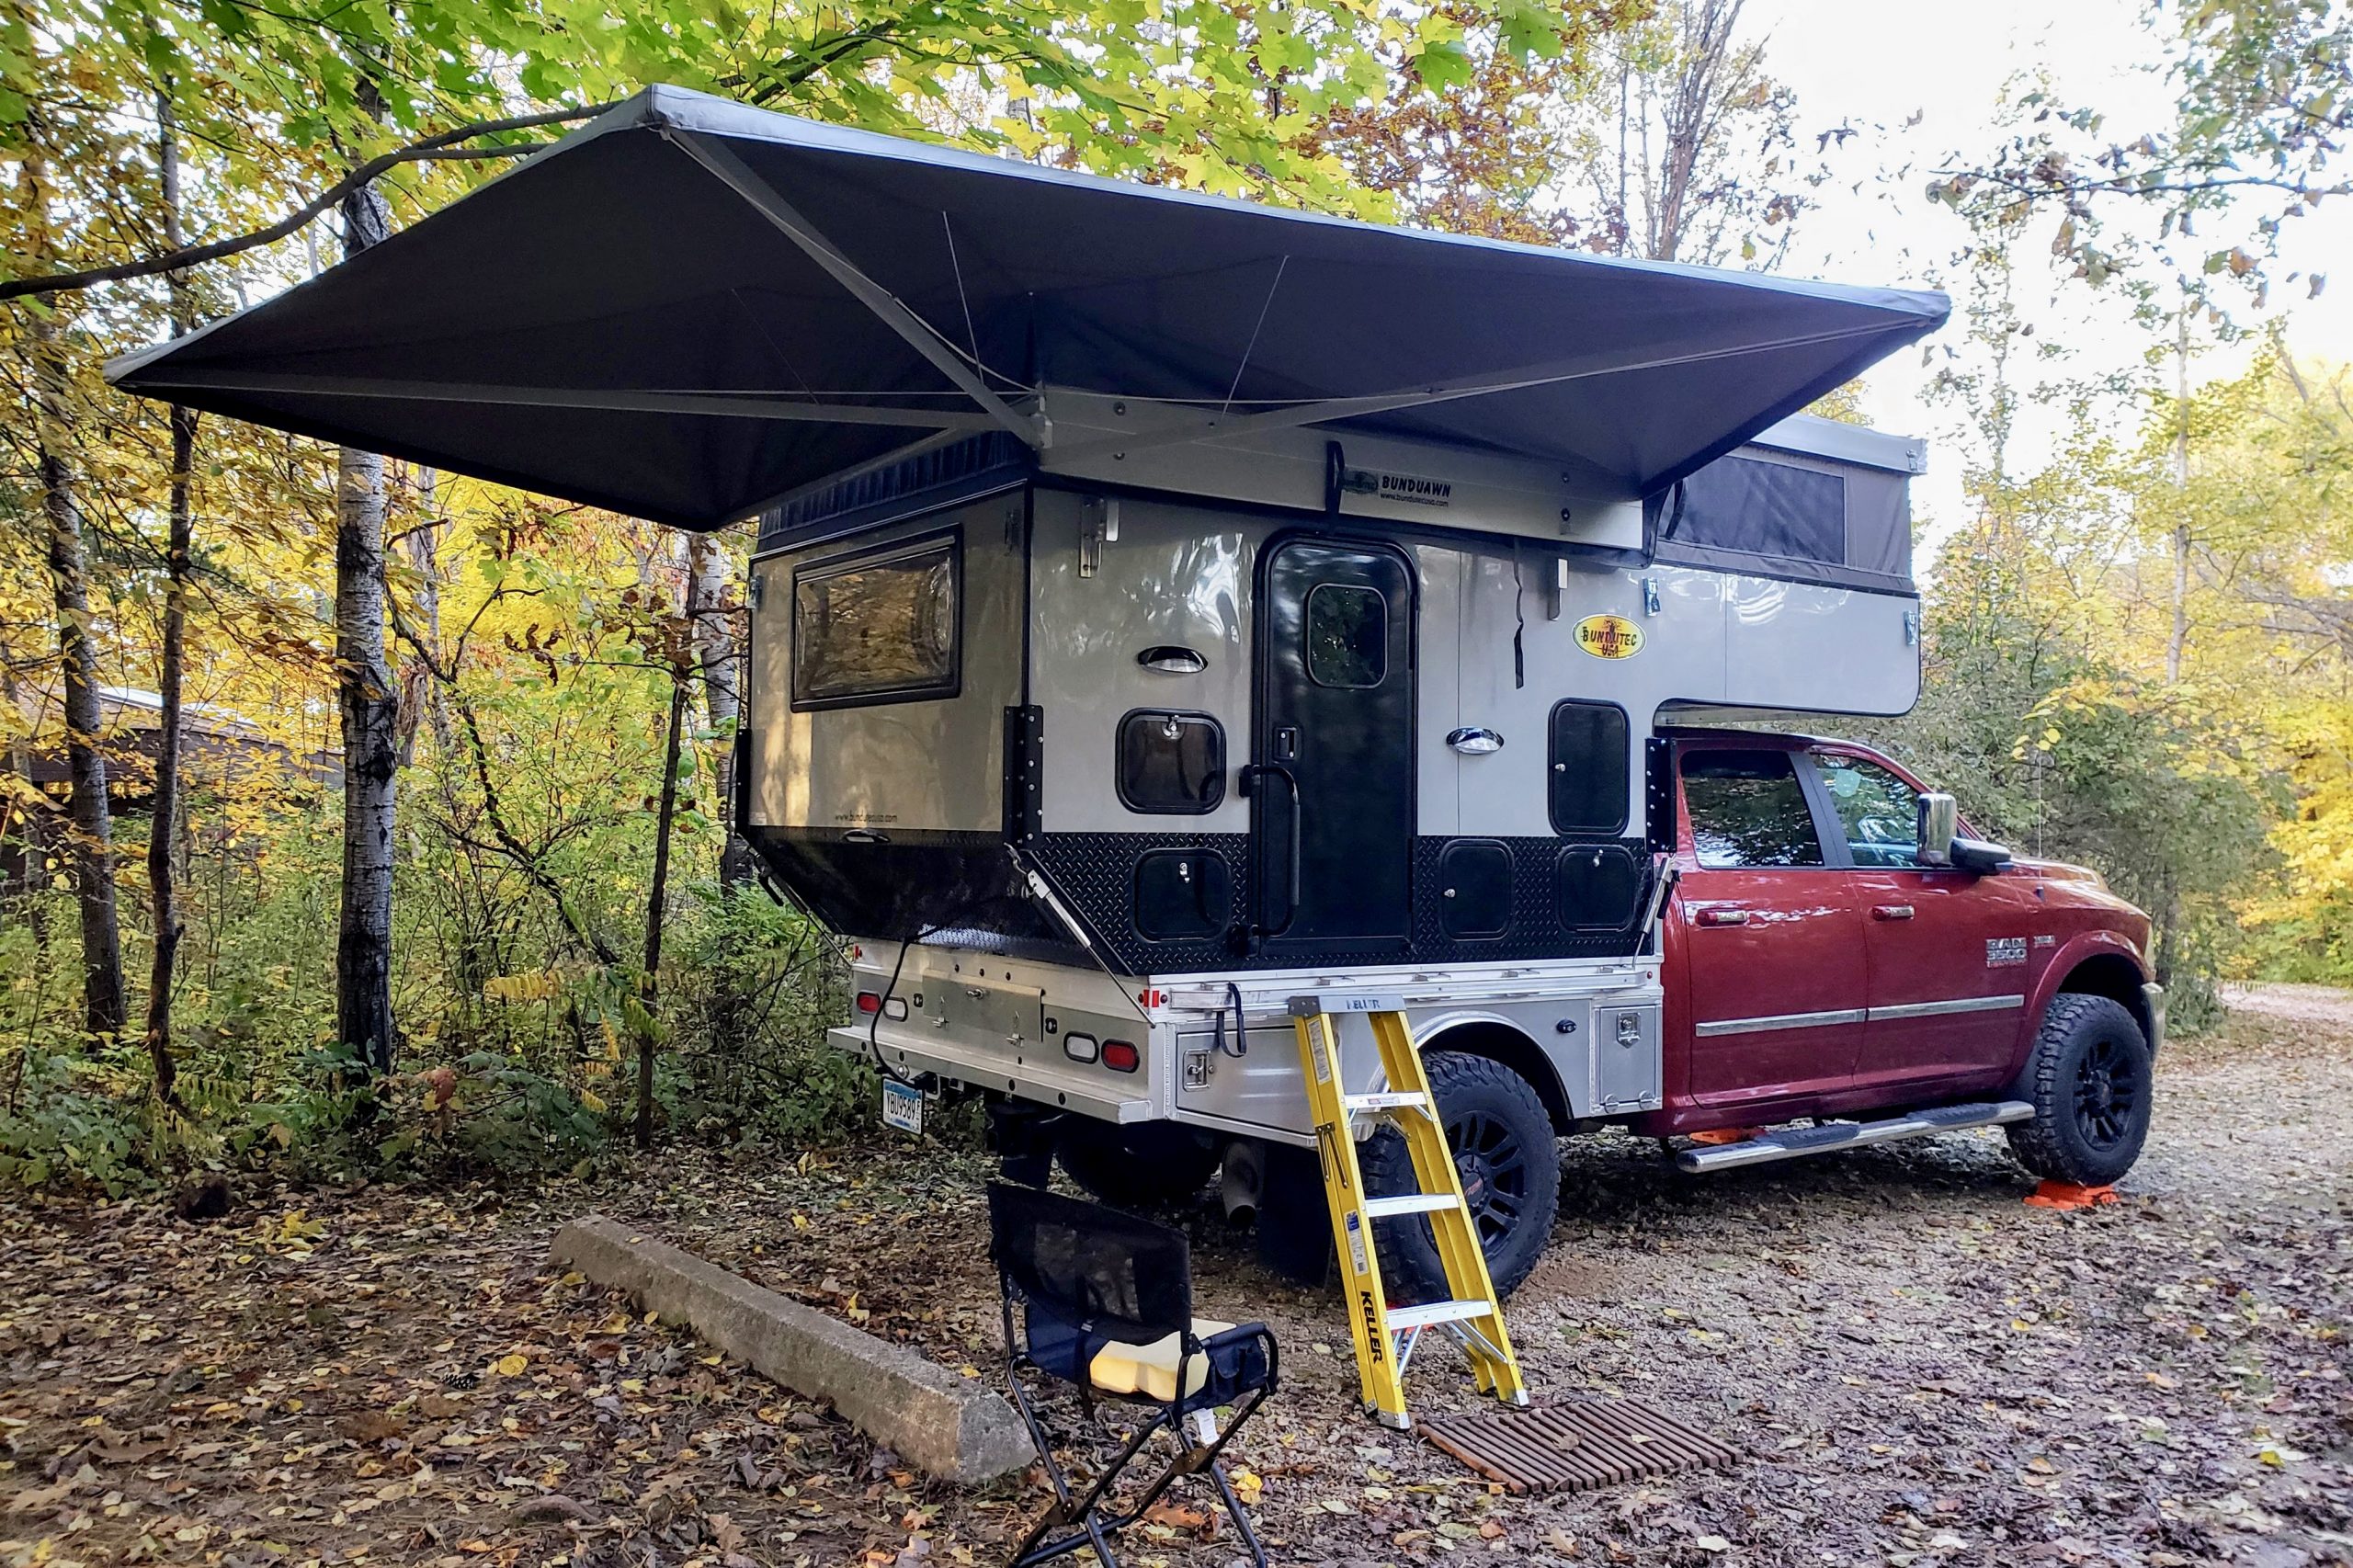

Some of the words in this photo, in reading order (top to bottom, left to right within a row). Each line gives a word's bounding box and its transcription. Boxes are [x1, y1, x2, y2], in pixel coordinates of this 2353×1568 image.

[1381, 475, 1451, 497] BUNDUAWN
[1582, 626, 1637, 646] BUNDUTEC
[1602, 643, 1619, 657] USA
[887, 1092, 915, 1120] YBU9589
[1360, 1290, 1383, 1365] KELLER
